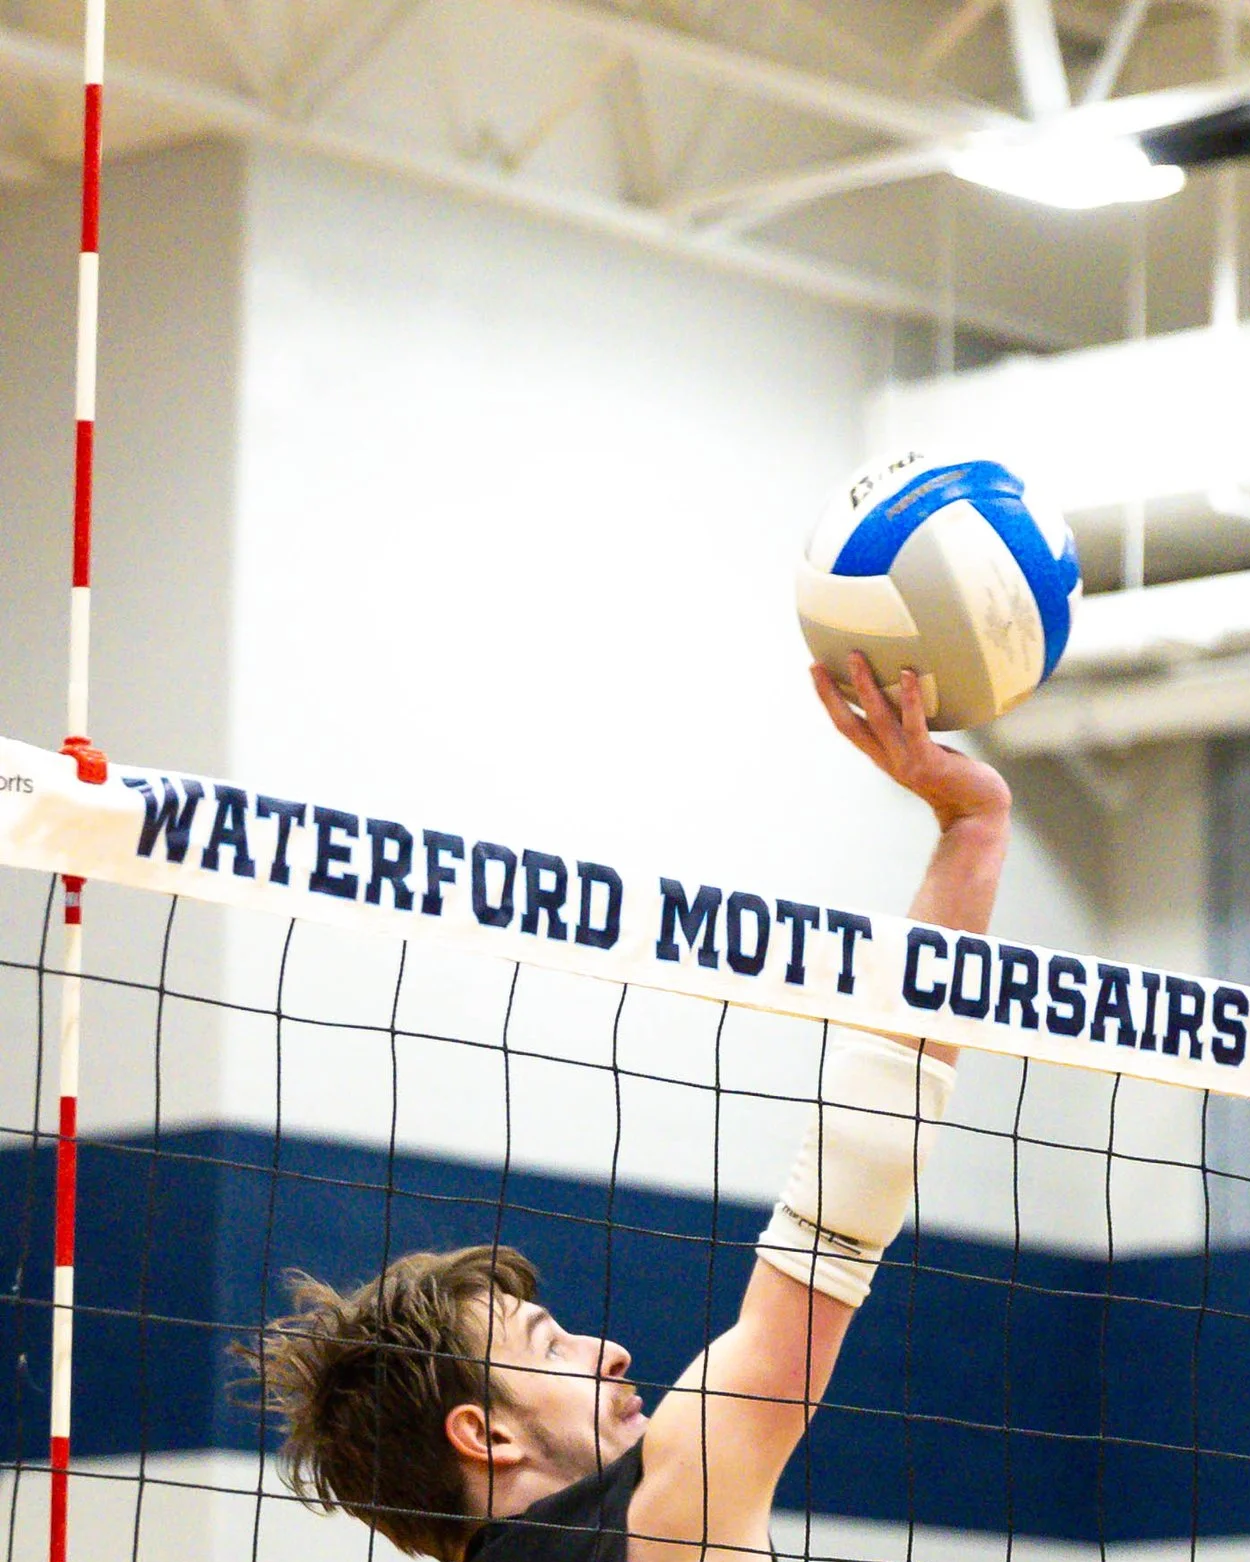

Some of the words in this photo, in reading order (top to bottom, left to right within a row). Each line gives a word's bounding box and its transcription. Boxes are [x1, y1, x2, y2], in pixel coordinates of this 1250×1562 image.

[122, 777, 623, 951] WATERFORD
[656, 878, 872, 994] MOTT
[902, 927, 1250, 1066] CORSAIRS
